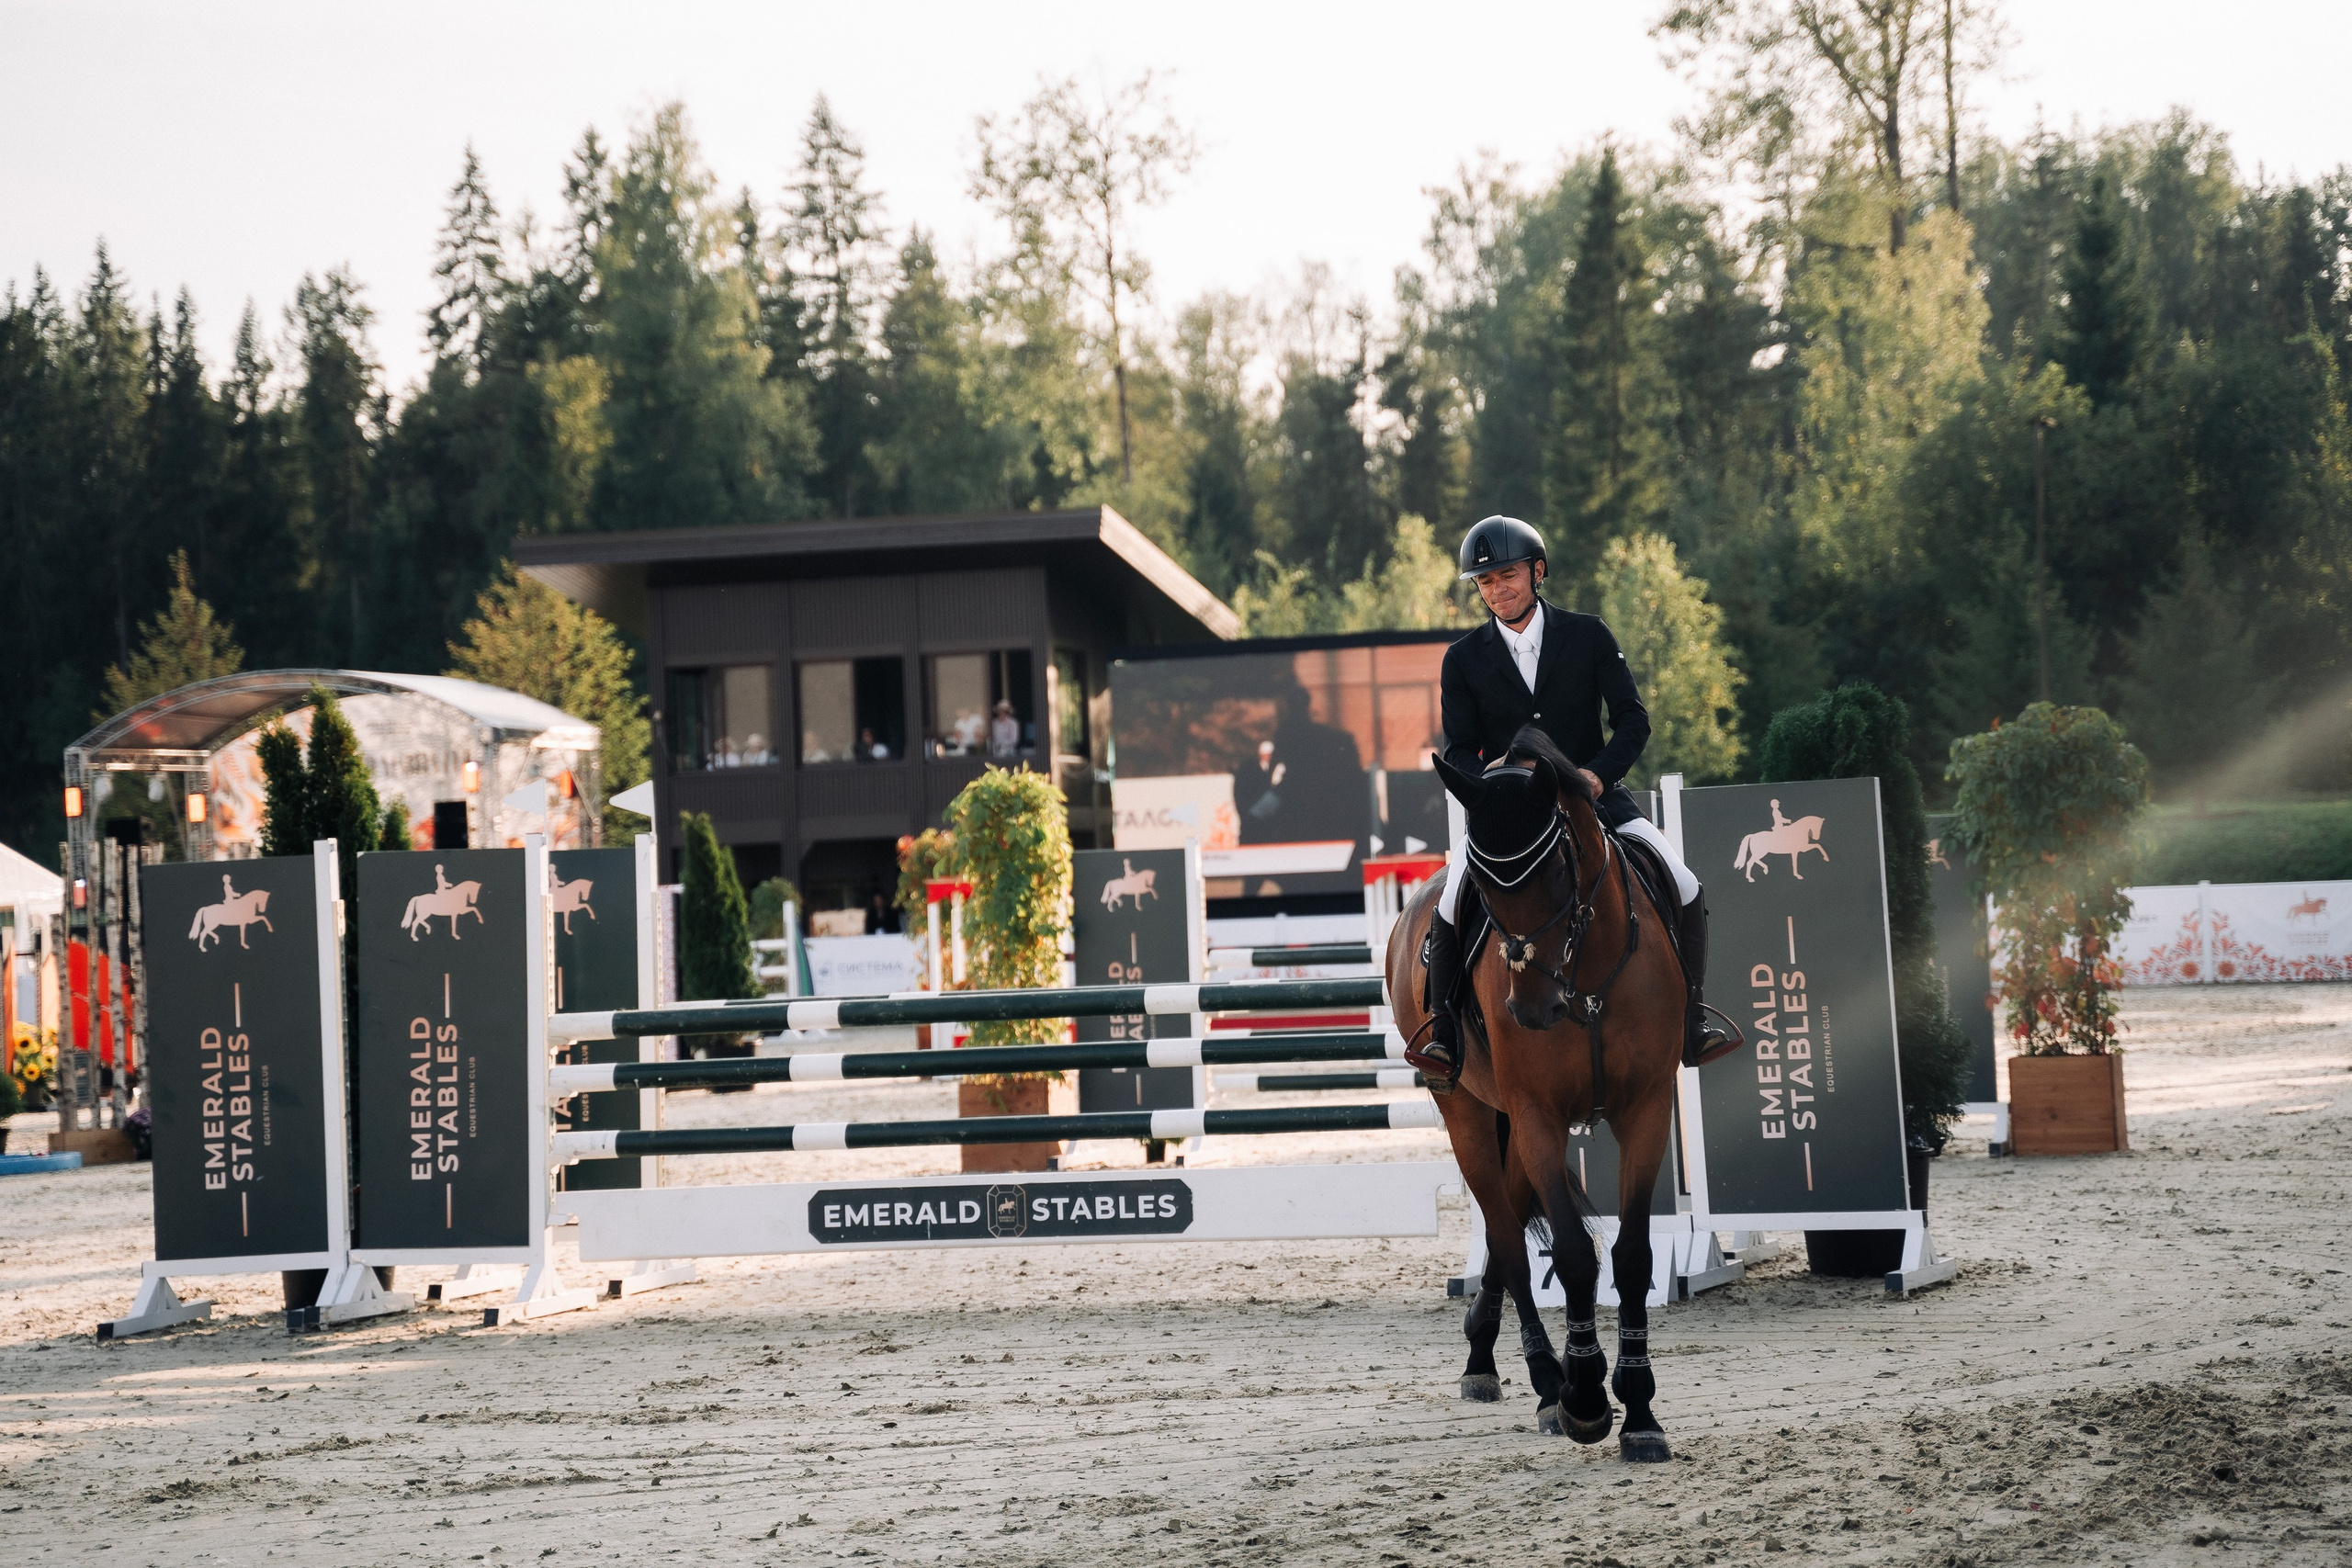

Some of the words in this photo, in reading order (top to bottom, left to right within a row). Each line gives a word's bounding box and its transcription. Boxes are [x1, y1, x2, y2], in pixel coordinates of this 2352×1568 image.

[1750, 963, 1787, 1139] EMERALD
[1781, 970, 1816, 1131] STABLES
[1822, 1005, 1830, 1029] CLUB
[1824, 1032, 1835, 1093] EQUESTRIAN
[200, 1027, 227, 1190] EMERALD
[227, 1033, 254, 1181] STABLES
[261, 1065, 269, 1088] CLUB
[262, 1090, 271, 1145] EQUESTRIAN
[410, 1016, 433, 1180] EMERALD
[435, 1023, 458, 1173] STABLES
[469, 1082, 477, 1137] EQUESTRIAN
[824, 1200, 981, 1229] EMERALD
[1031, 1194, 1177, 1223] STABLES
